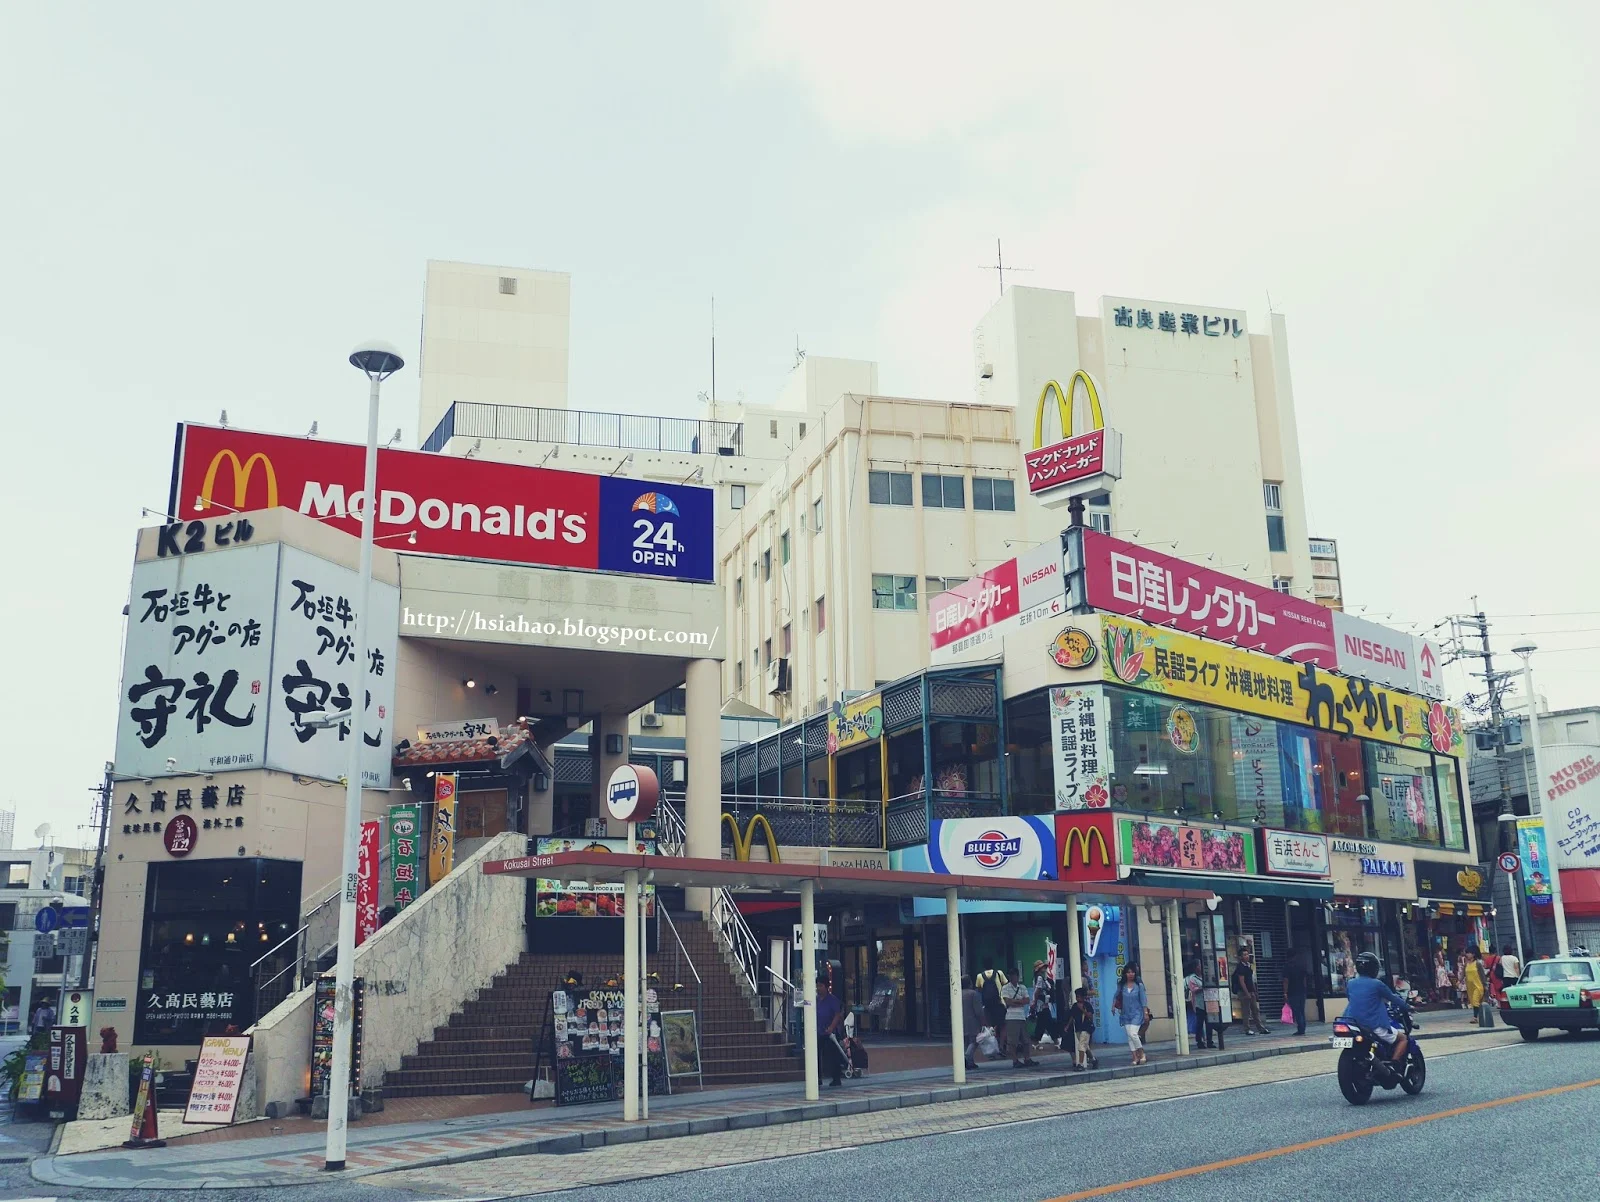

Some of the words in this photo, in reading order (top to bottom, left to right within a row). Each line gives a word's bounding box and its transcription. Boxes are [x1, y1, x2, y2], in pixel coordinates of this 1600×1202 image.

[1027, 437, 1099, 468] マクドナルド
[1029, 454, 1100, 483] ハンバーガー
[299, 481, 587, 544] McDonald's
[157, 521, 206, 556] K2
[214, 519, 255, 546] ビル
[632, 551, 677, 567] OPEN
[1022, 563, 1057, 586] NISSAN
[140, 584, 231, 623] 石垣牛と
[291, 579, 358, 629] 石垣牛
[935, 584, 1011, 633] 日産レンタカー
[1110, 551, 1276, 636] 日産レンタカー
[173, 619, 261, 655] アグーの店
[1344, 634, 1406, 670] NISSAN
[1155, 646, 1221, 688] 民謡ライブ
[1225, 666, 1294, 707] 沖縄地料理
[128, 665, 256, 748] 守礼
[1298, 662, 1404, 742] わらゆい
[1078, 697, 1098, 775] 沖縄地料理
[1061, 718, 1080, 798] 民謡ライブ
[1549, 755, 1595, 785] MUSIC
[1547, 778, 1576, 801] PRO
[1568, 807, 1581, 819] CD
[502, 858, 530, 870] Kokusai
[531, 855, 554, 868] Street
[855, 860, 883, 870] HABA
[968, 843, 992, 853] BLUE
[994, 841, 1018, 852] SEAL
[818, 930, 827, 944] K2
